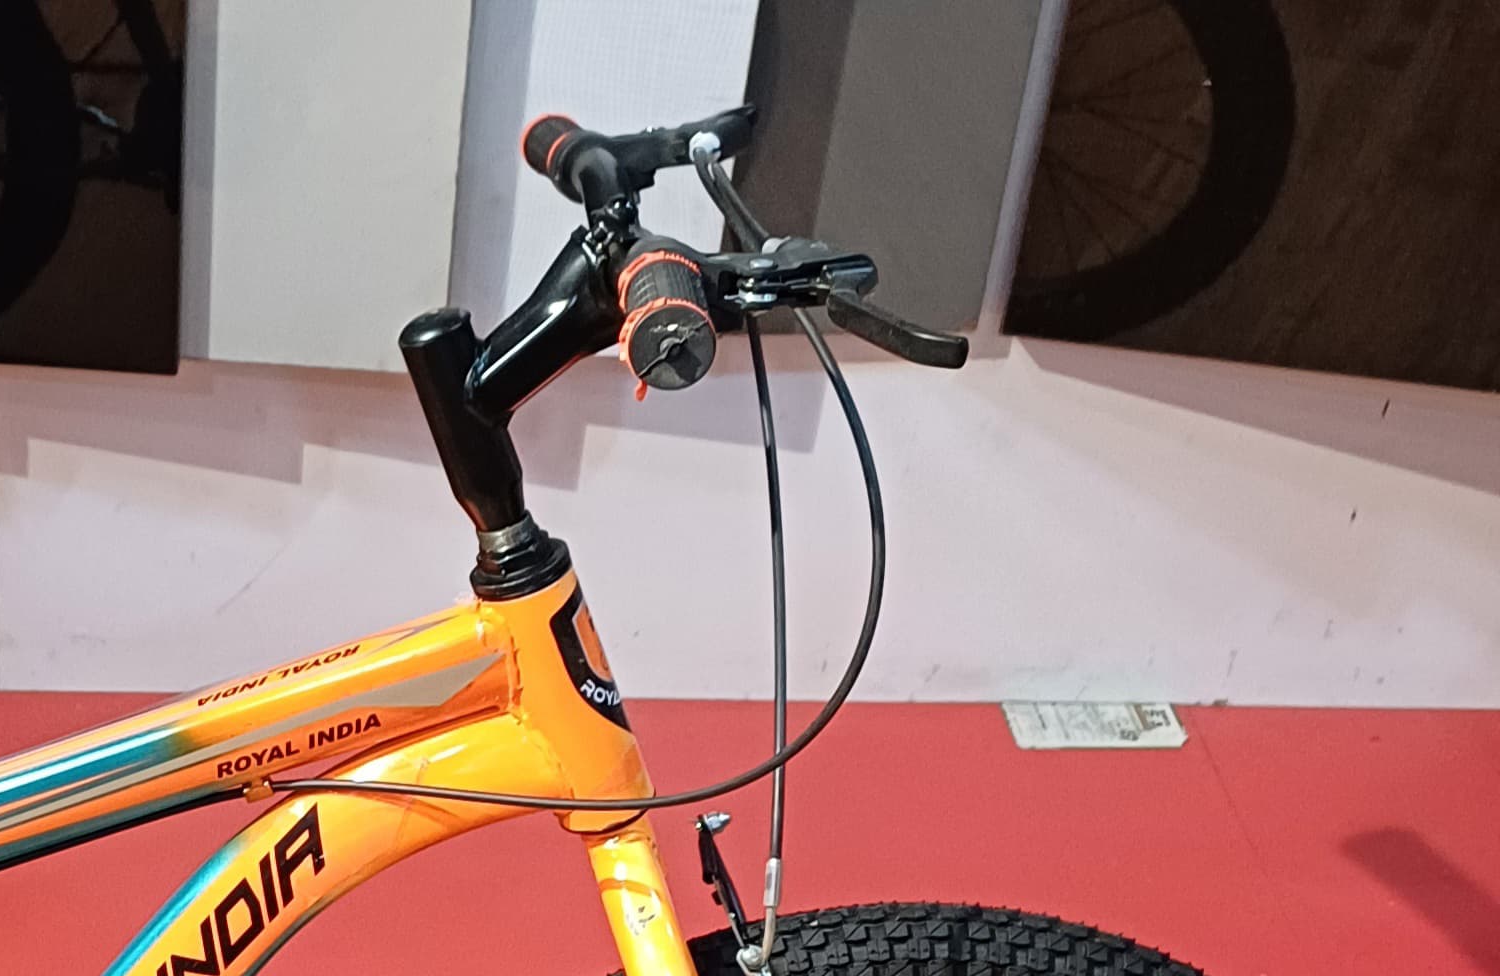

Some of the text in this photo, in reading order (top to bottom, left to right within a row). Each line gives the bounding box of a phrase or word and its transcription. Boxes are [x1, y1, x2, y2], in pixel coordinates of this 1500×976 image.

[196, 644, 361, 708] ROYAL INDIA
[216, 713, 382, 779] ROYAL INDIA
